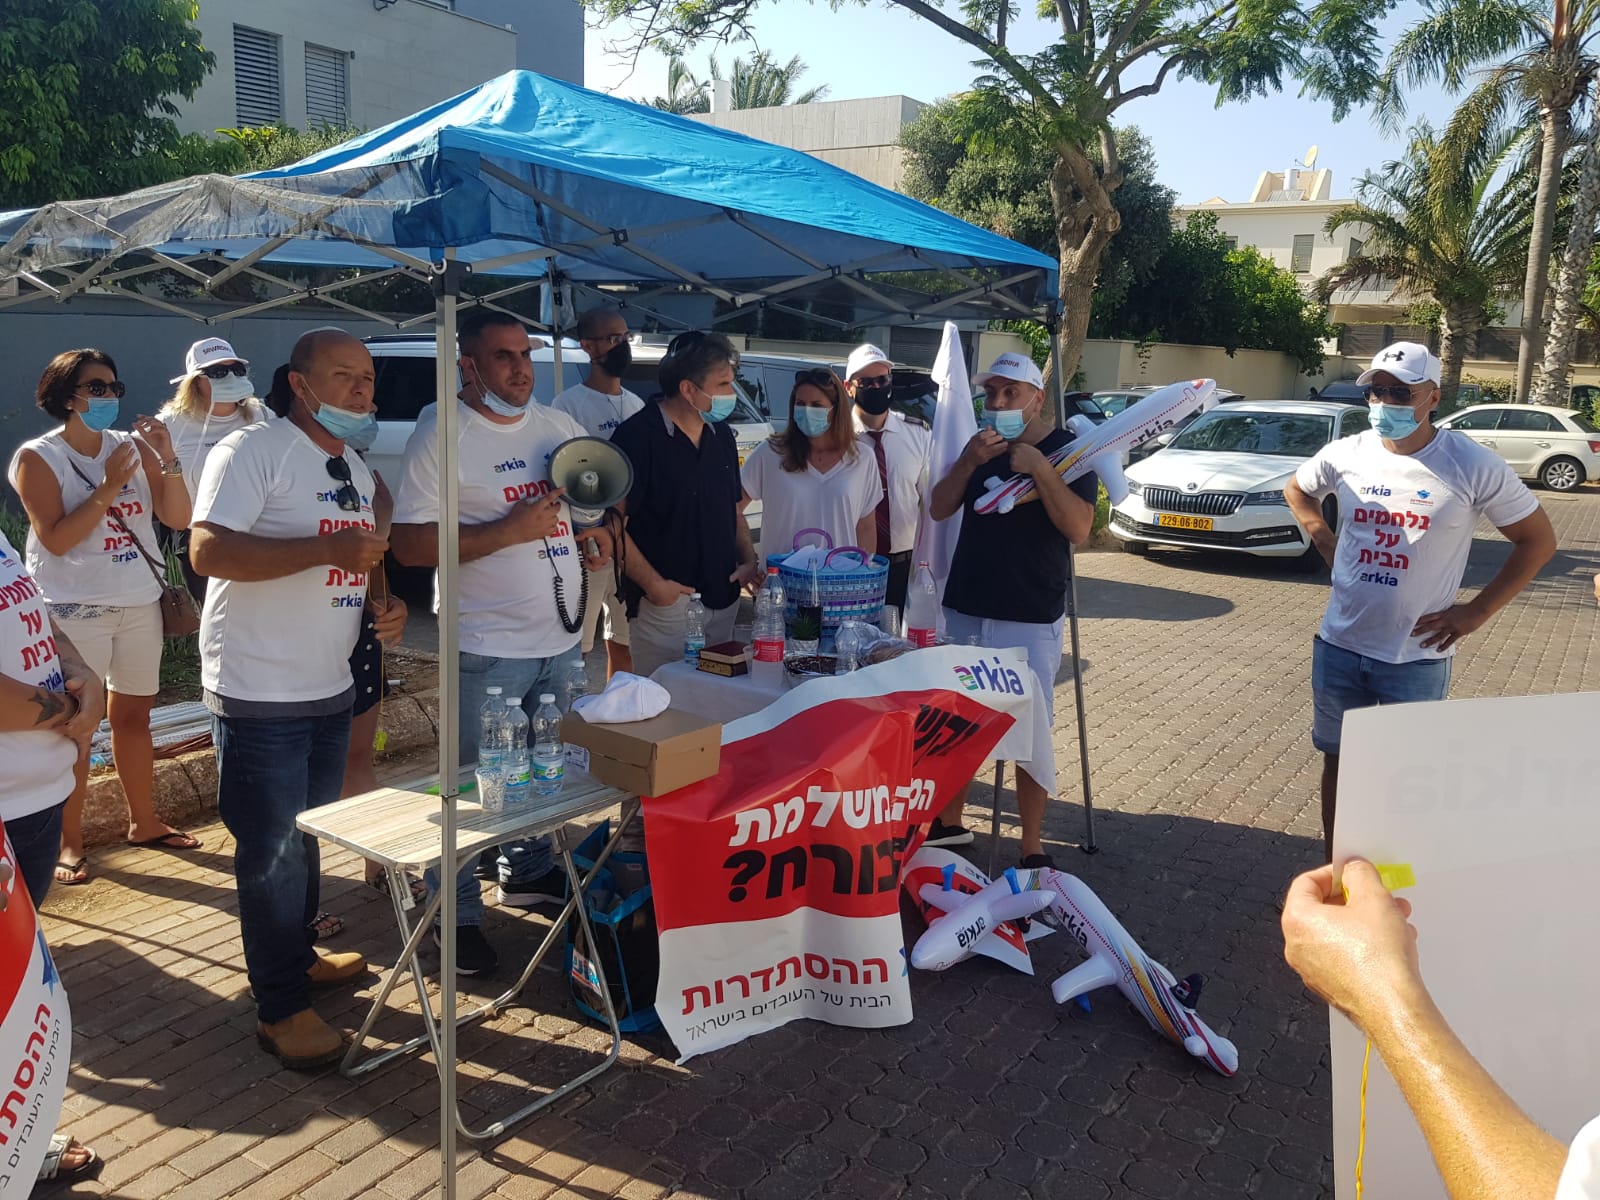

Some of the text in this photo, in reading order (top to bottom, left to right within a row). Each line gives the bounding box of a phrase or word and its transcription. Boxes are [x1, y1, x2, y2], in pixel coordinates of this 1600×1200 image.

[494, 458, 527, 473] arkia
[1360, 484, 1391, 496] arkia
[1354, 508, 1430, 530] נלחמים
[1374, 528, 1400, 548] על
[1359, 549, 1409, 570] הבית
[1360, 572, 1398, 586] arkia
[331, 593, 362, 607] arkia
[18, 608, 42, 637] על
[952, 656, 1025, 696] arkia
[681, 953, 889, 1015] ההסתדרות
[686, 988, 891, 1041] הבית של העובדים בישראל
[8, 1019, 61, 1169] הבית של העובדים
